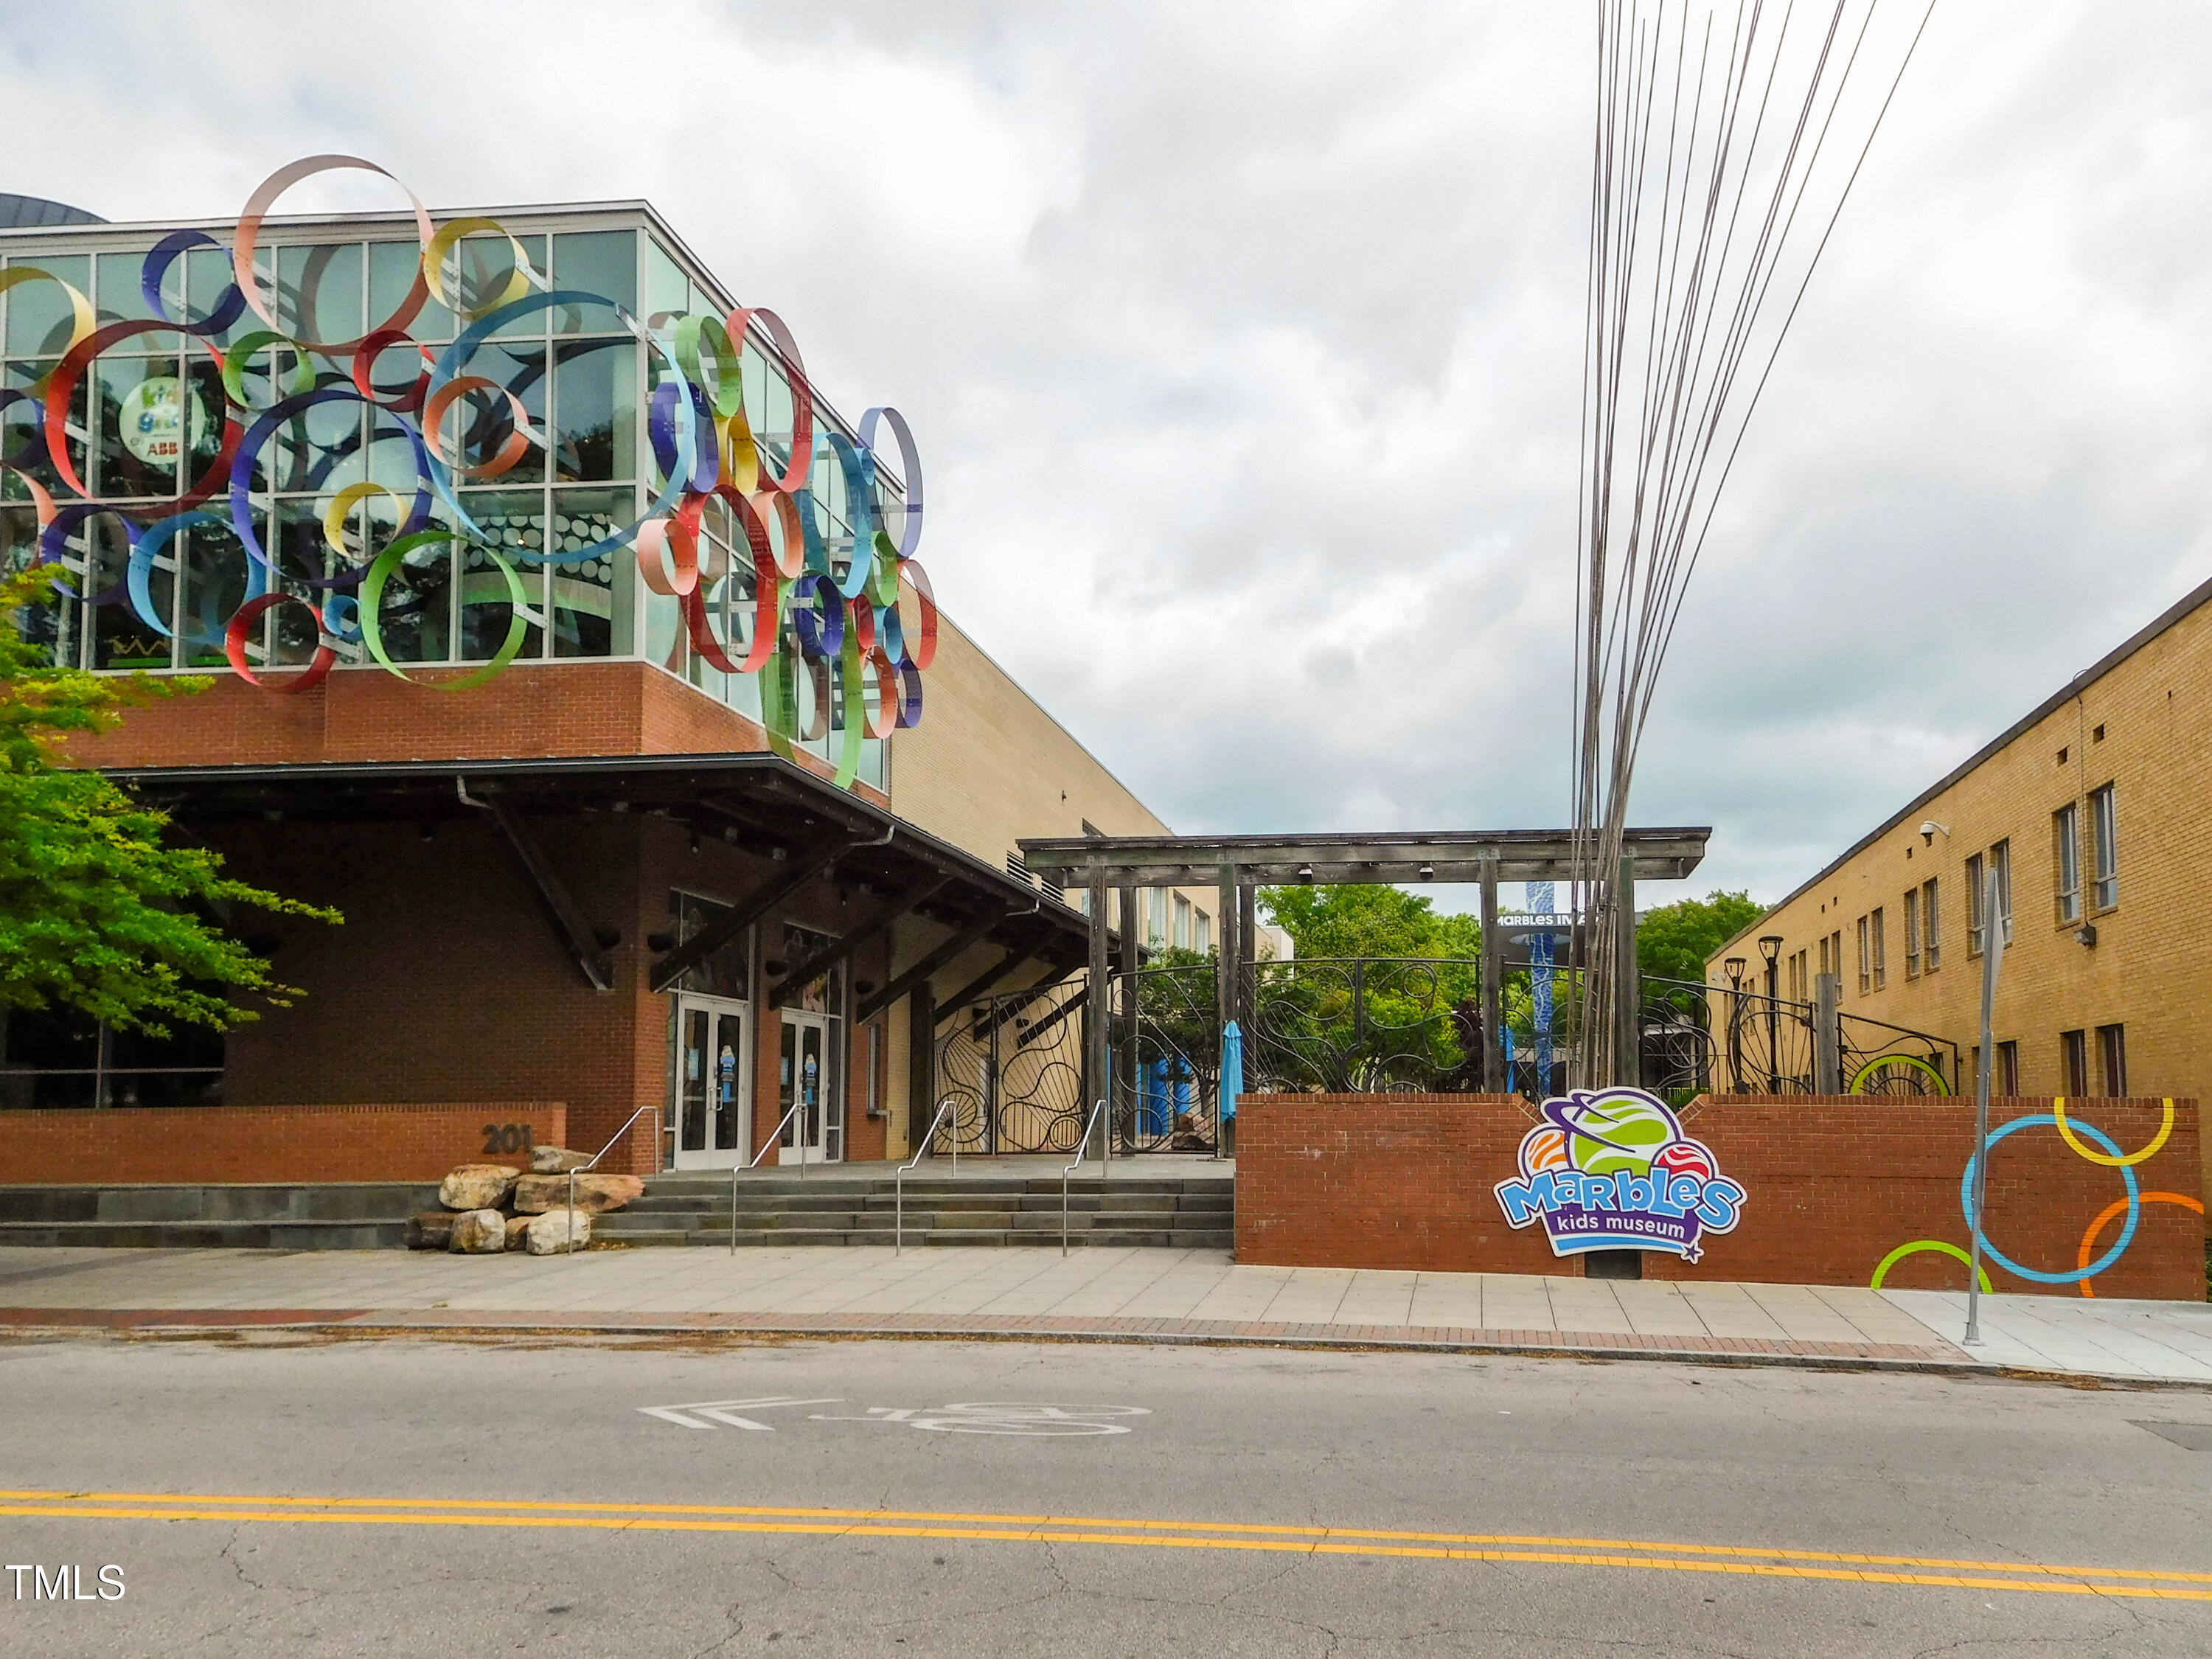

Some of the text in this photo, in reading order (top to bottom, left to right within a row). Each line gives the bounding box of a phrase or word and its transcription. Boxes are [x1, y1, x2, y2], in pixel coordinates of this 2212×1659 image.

[147, 442, 178, 456] ABB
[483, 1124, 532, 1154] 201
[1557, 1216, 1685, 1239] kids museum
